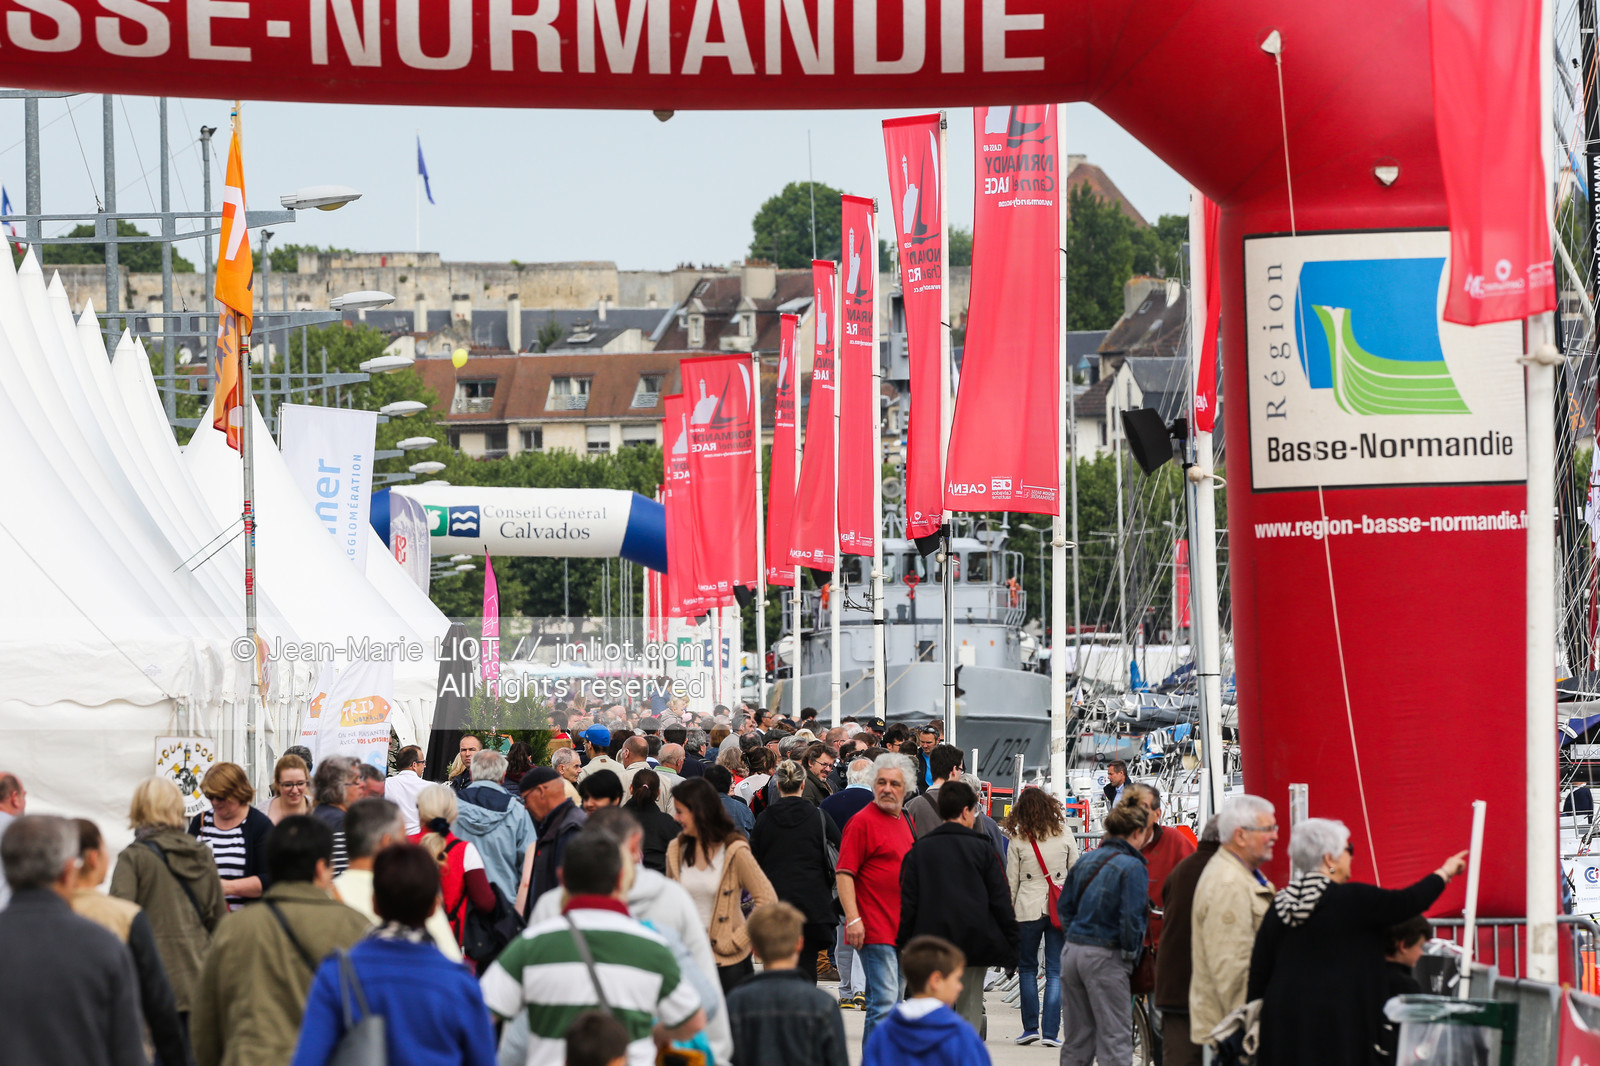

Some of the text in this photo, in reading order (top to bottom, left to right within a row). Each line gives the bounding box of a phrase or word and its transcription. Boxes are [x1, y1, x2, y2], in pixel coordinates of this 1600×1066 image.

[0, 0, 1045, 76] SSE-NORMANDIE
[1263, 261, 1291, 422] Région
[1267, 430, 1514, 464] Basse-Normandie
[346, 454, 362, 560] GGLOMÉRATION
[483, 505, 607, 520] Conseil Général
[500, 520, 591, 541] Calvados
[342, 700, 375, 722] TRIP
[368, 736, 389, 744] LOISIRS
[158, 742, 214, 766] AQUA DOG
